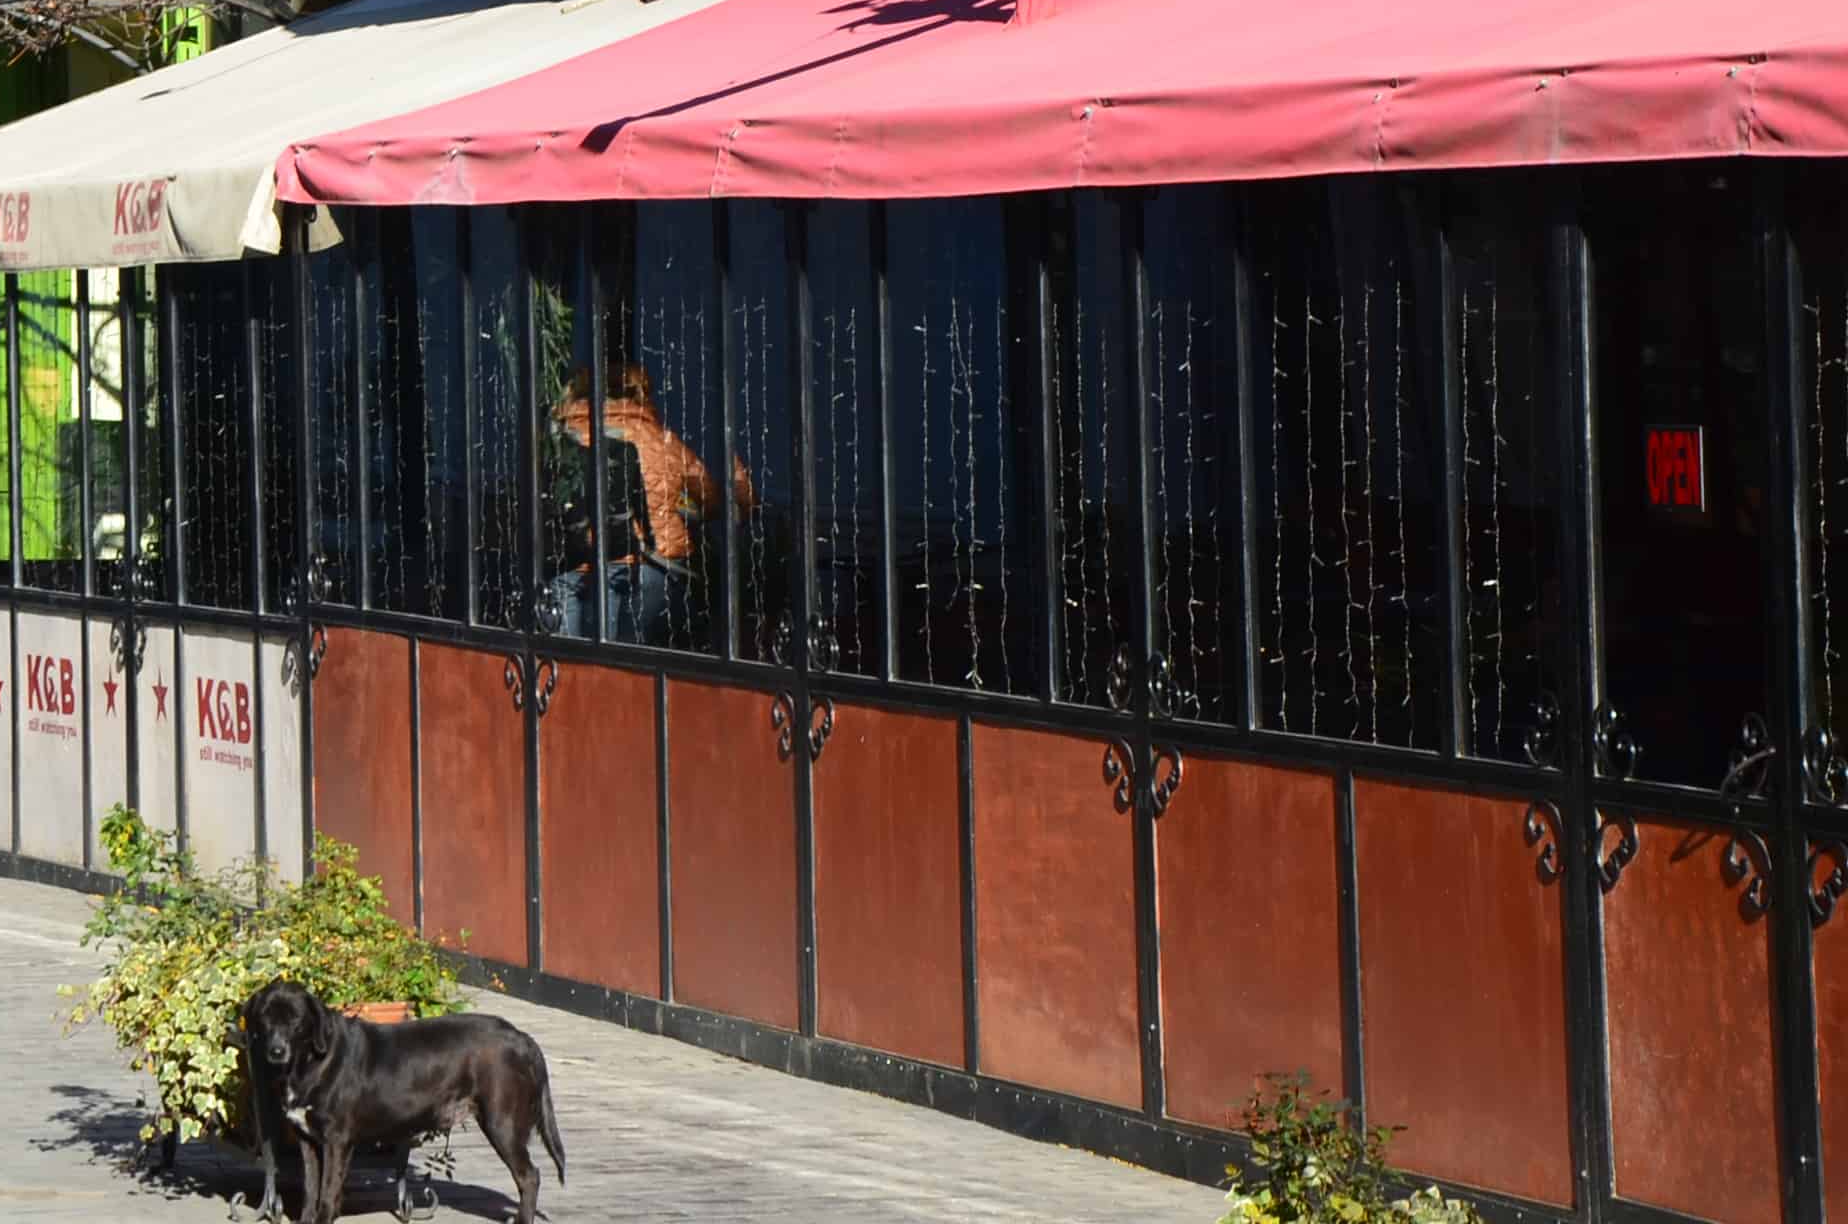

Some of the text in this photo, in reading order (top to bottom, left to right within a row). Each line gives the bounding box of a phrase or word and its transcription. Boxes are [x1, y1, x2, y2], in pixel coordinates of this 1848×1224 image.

[1647, 429, 1701, 505] OPEN
[28, 718, 40, 732] still
[41, 720, 67, 740] watching
[199, 745, 213, 761] still
[214, 750, 242, 770] watching
